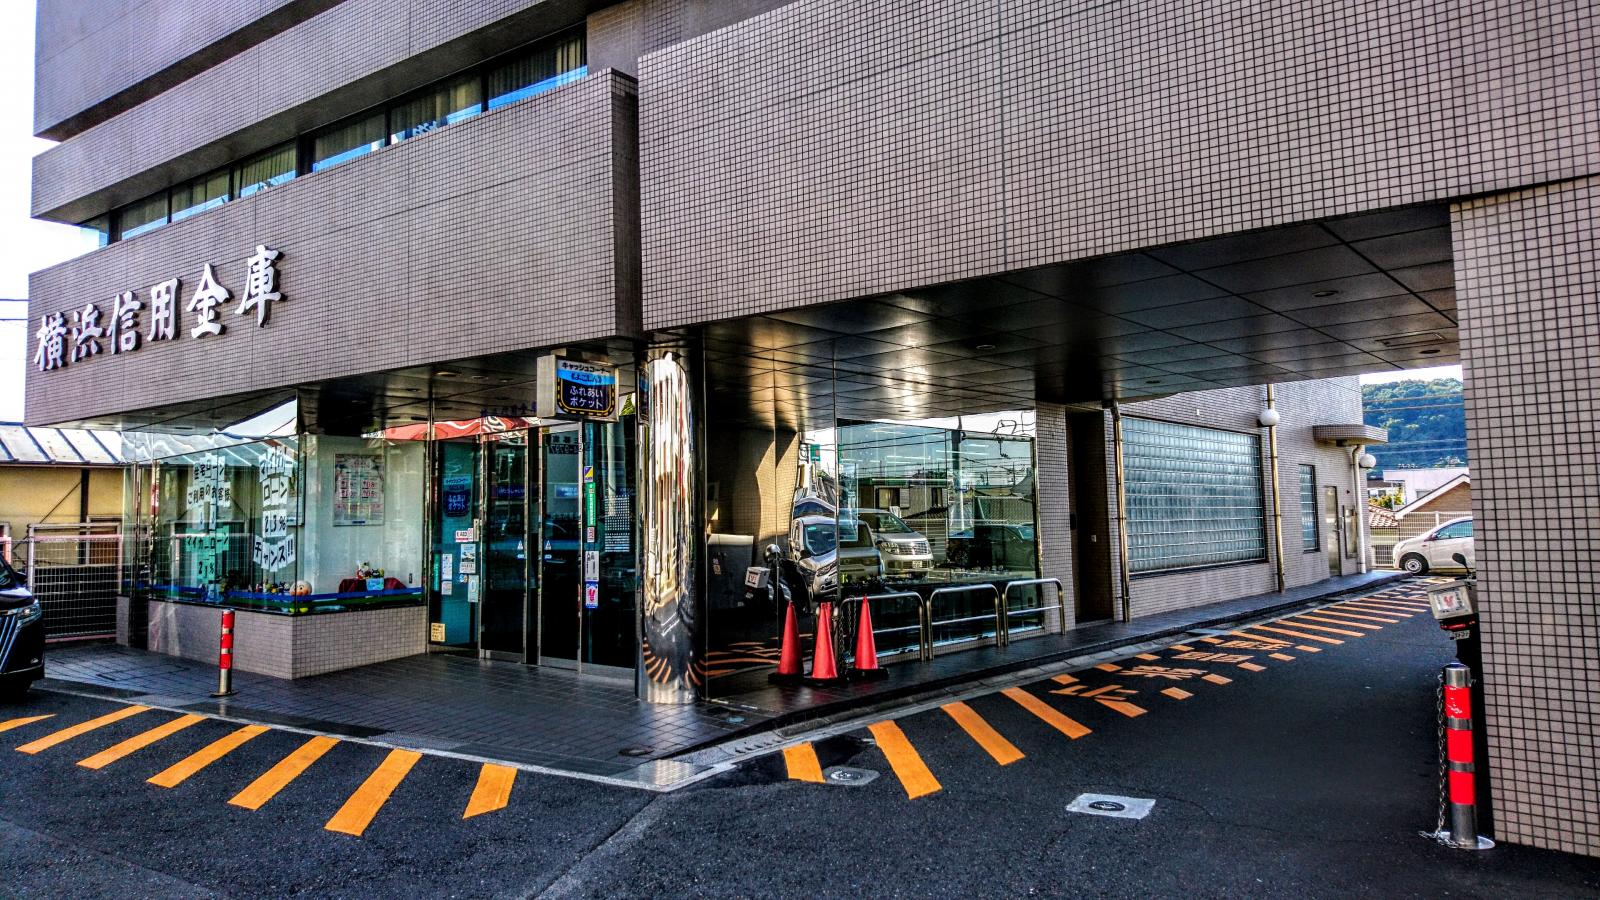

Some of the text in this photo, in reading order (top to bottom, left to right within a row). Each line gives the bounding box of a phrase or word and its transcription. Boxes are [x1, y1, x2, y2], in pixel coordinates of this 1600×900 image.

[33, 244, 283, 371] 横浜信用金庫
[562, 362, 611, 373] キャッシュコーナー
[569, 385, 603, 398] ふれあい
[570, 397, 603, 409] ポケット
[264, 481, 287, 501] ローン
